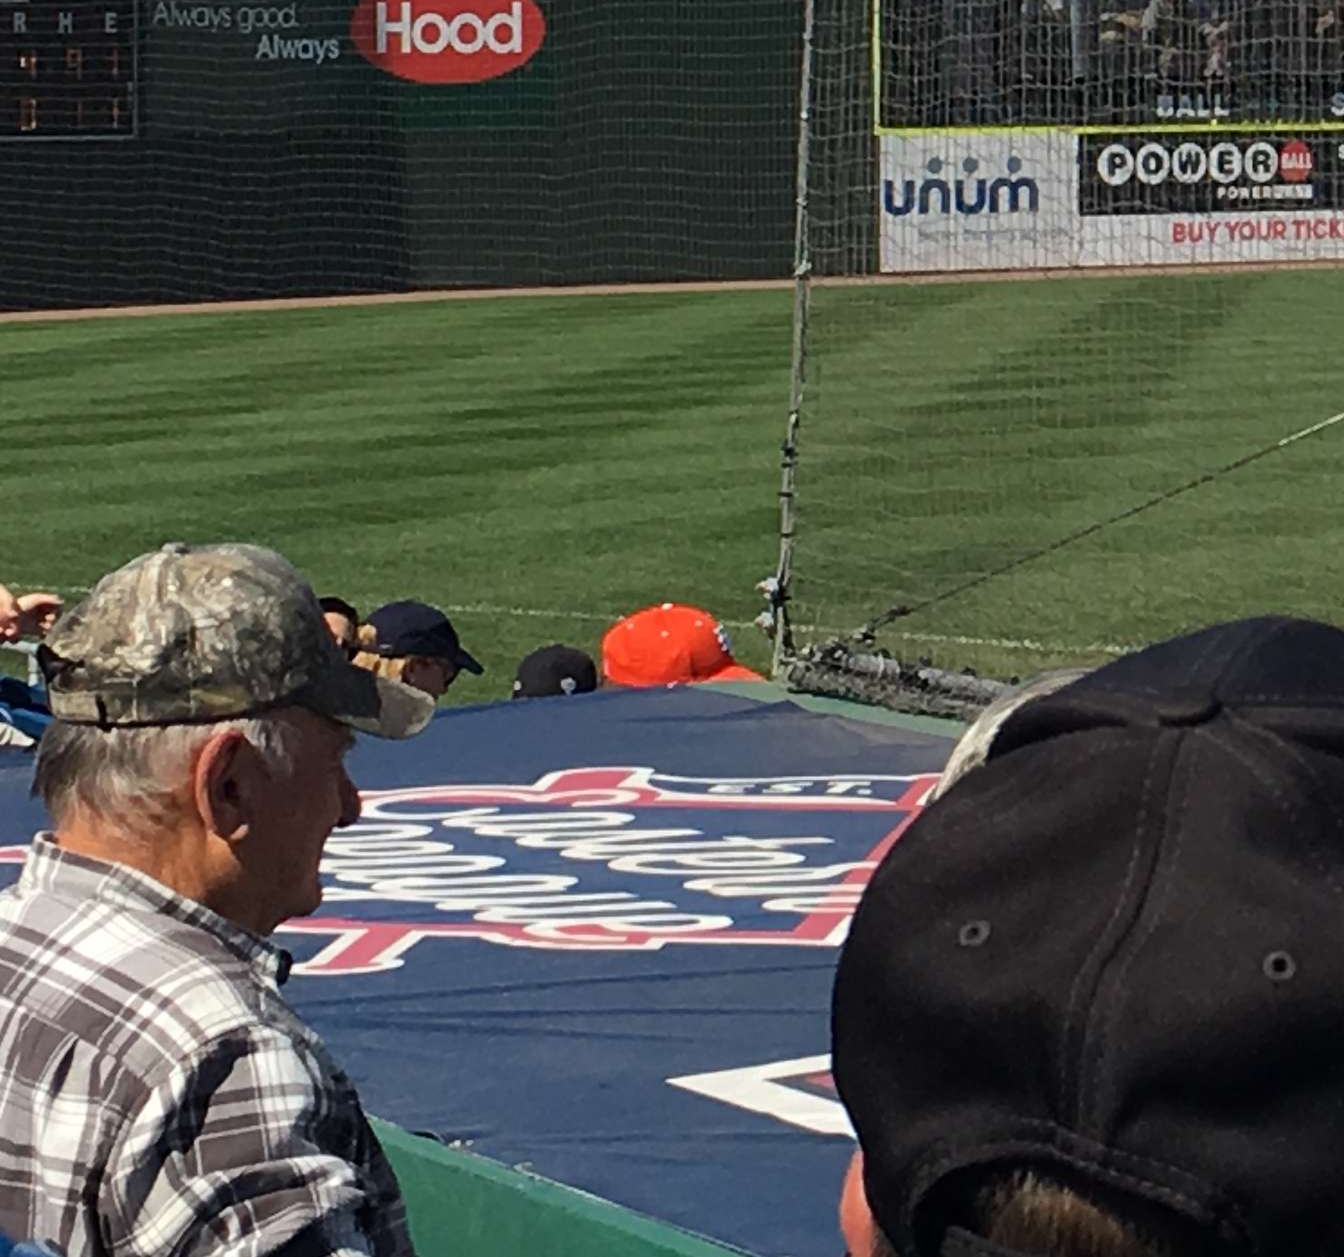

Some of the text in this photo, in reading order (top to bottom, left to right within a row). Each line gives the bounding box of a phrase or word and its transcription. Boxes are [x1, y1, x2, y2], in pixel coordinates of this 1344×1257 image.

[13, 12, 118, 33] R H E
[152, 1, 232, 33] Always
[376, 1, 524, 54] Hood
[255, 34, 341, 64] Always
[1101, 145, 1313, 182] POWER BALL
[883, 161, 1039, 216] unum
[1172, 219, 1217, 243] BUY
[1226, 218, 1287, 242] YOUR
[708, 780, 873, 796] EST.
